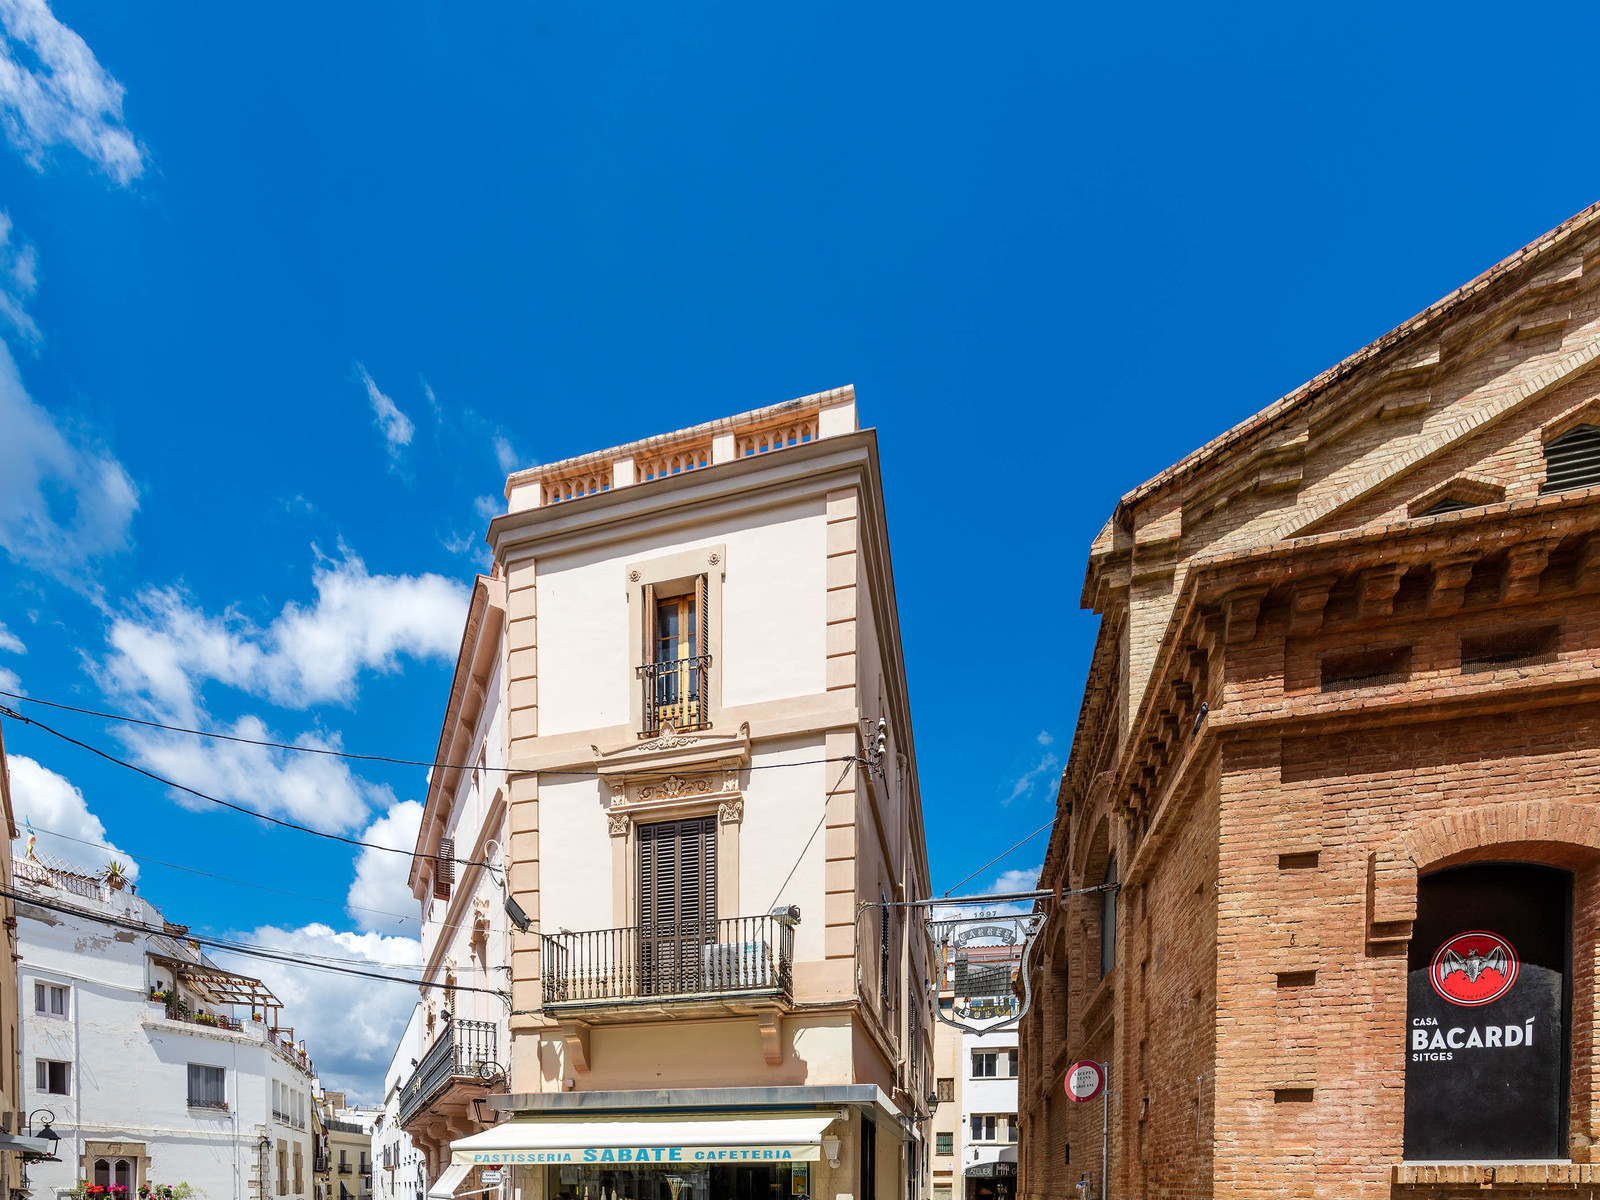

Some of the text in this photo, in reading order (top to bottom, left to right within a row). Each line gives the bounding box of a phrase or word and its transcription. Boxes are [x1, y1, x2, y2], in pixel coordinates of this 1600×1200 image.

[1412, 1017, 1438, 1026] CASA
[1412, 1016, 1535, 1050] BACARDÍ
[1412, 1052, 1453, 1062] SITGES
[474, 1148, 792, 1163] PASTISSERIA SABATE CAFETERIA
